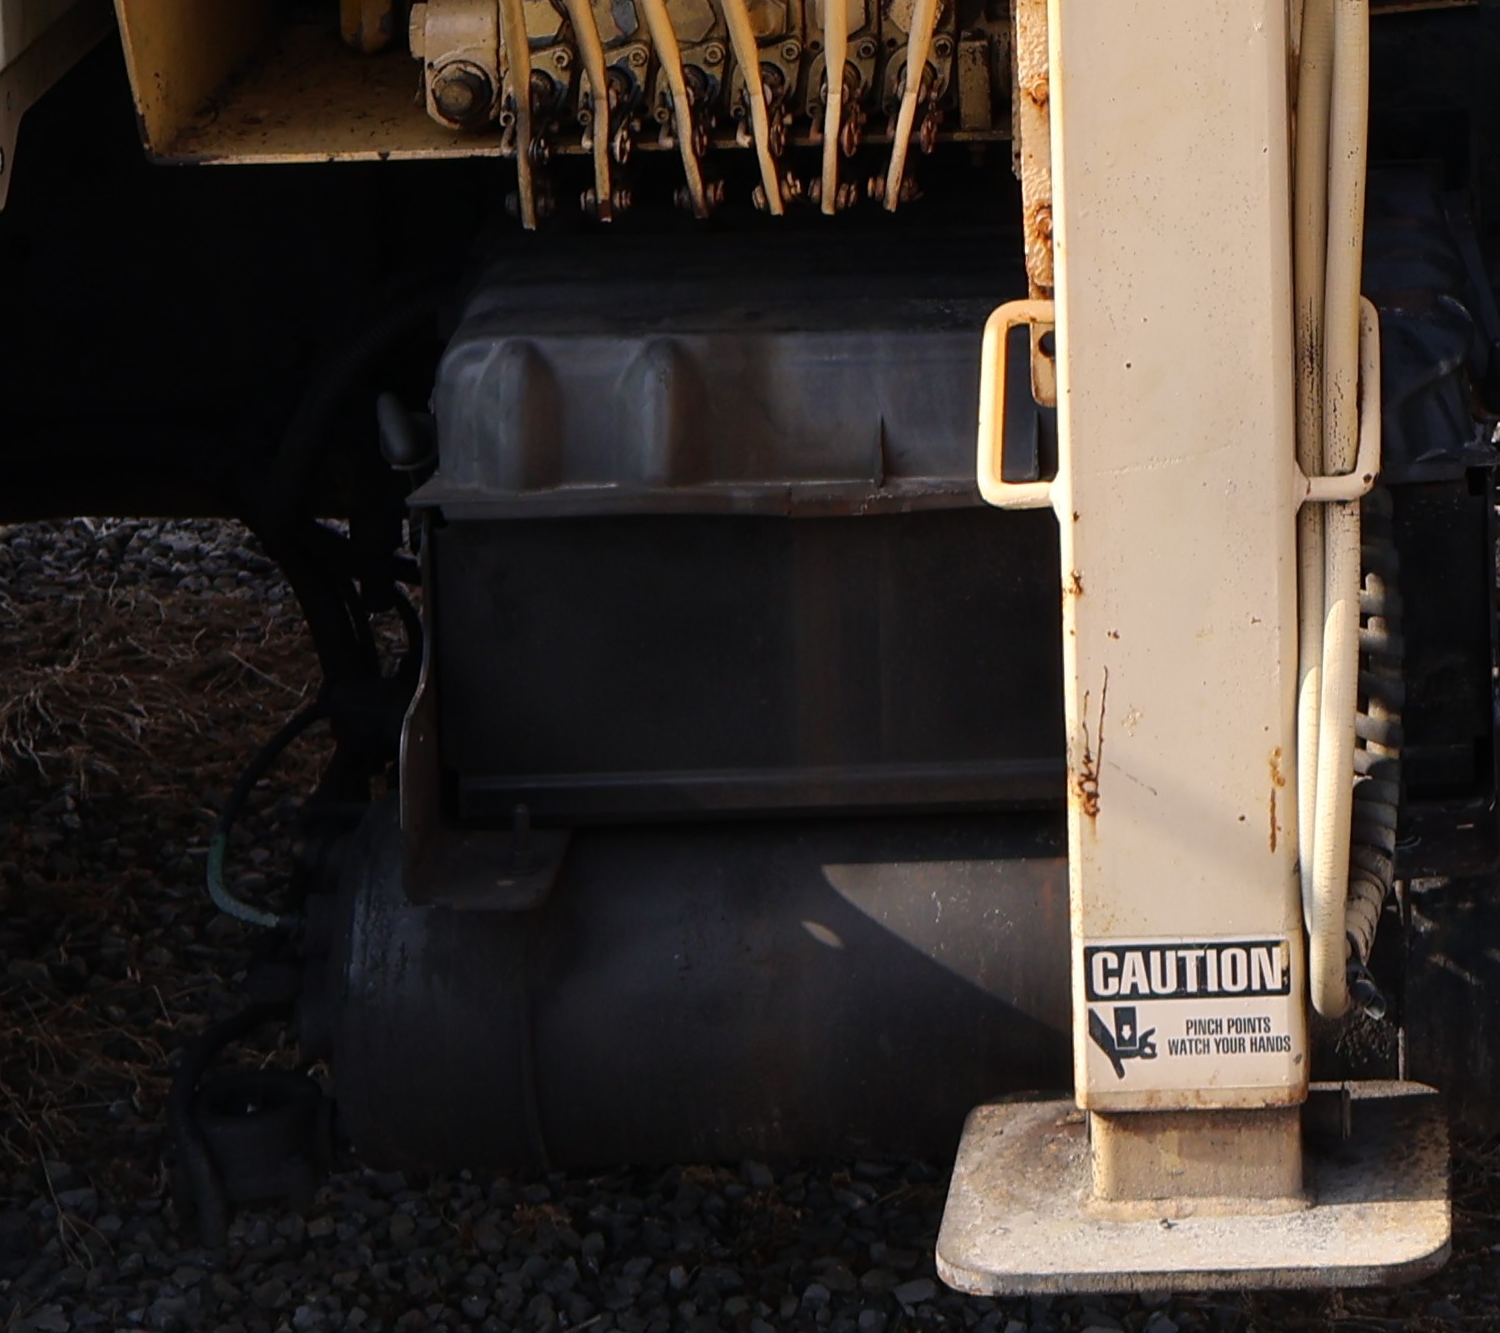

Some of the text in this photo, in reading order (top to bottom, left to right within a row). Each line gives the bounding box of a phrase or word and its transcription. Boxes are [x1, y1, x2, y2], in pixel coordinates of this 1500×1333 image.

[1091, 947, 1283, 996] CAUTION
[1185, 1017, 1271, 1035] PINCH POINTS
[1168, 1035, 1291, 1054] WATCH YOUR HANDS
